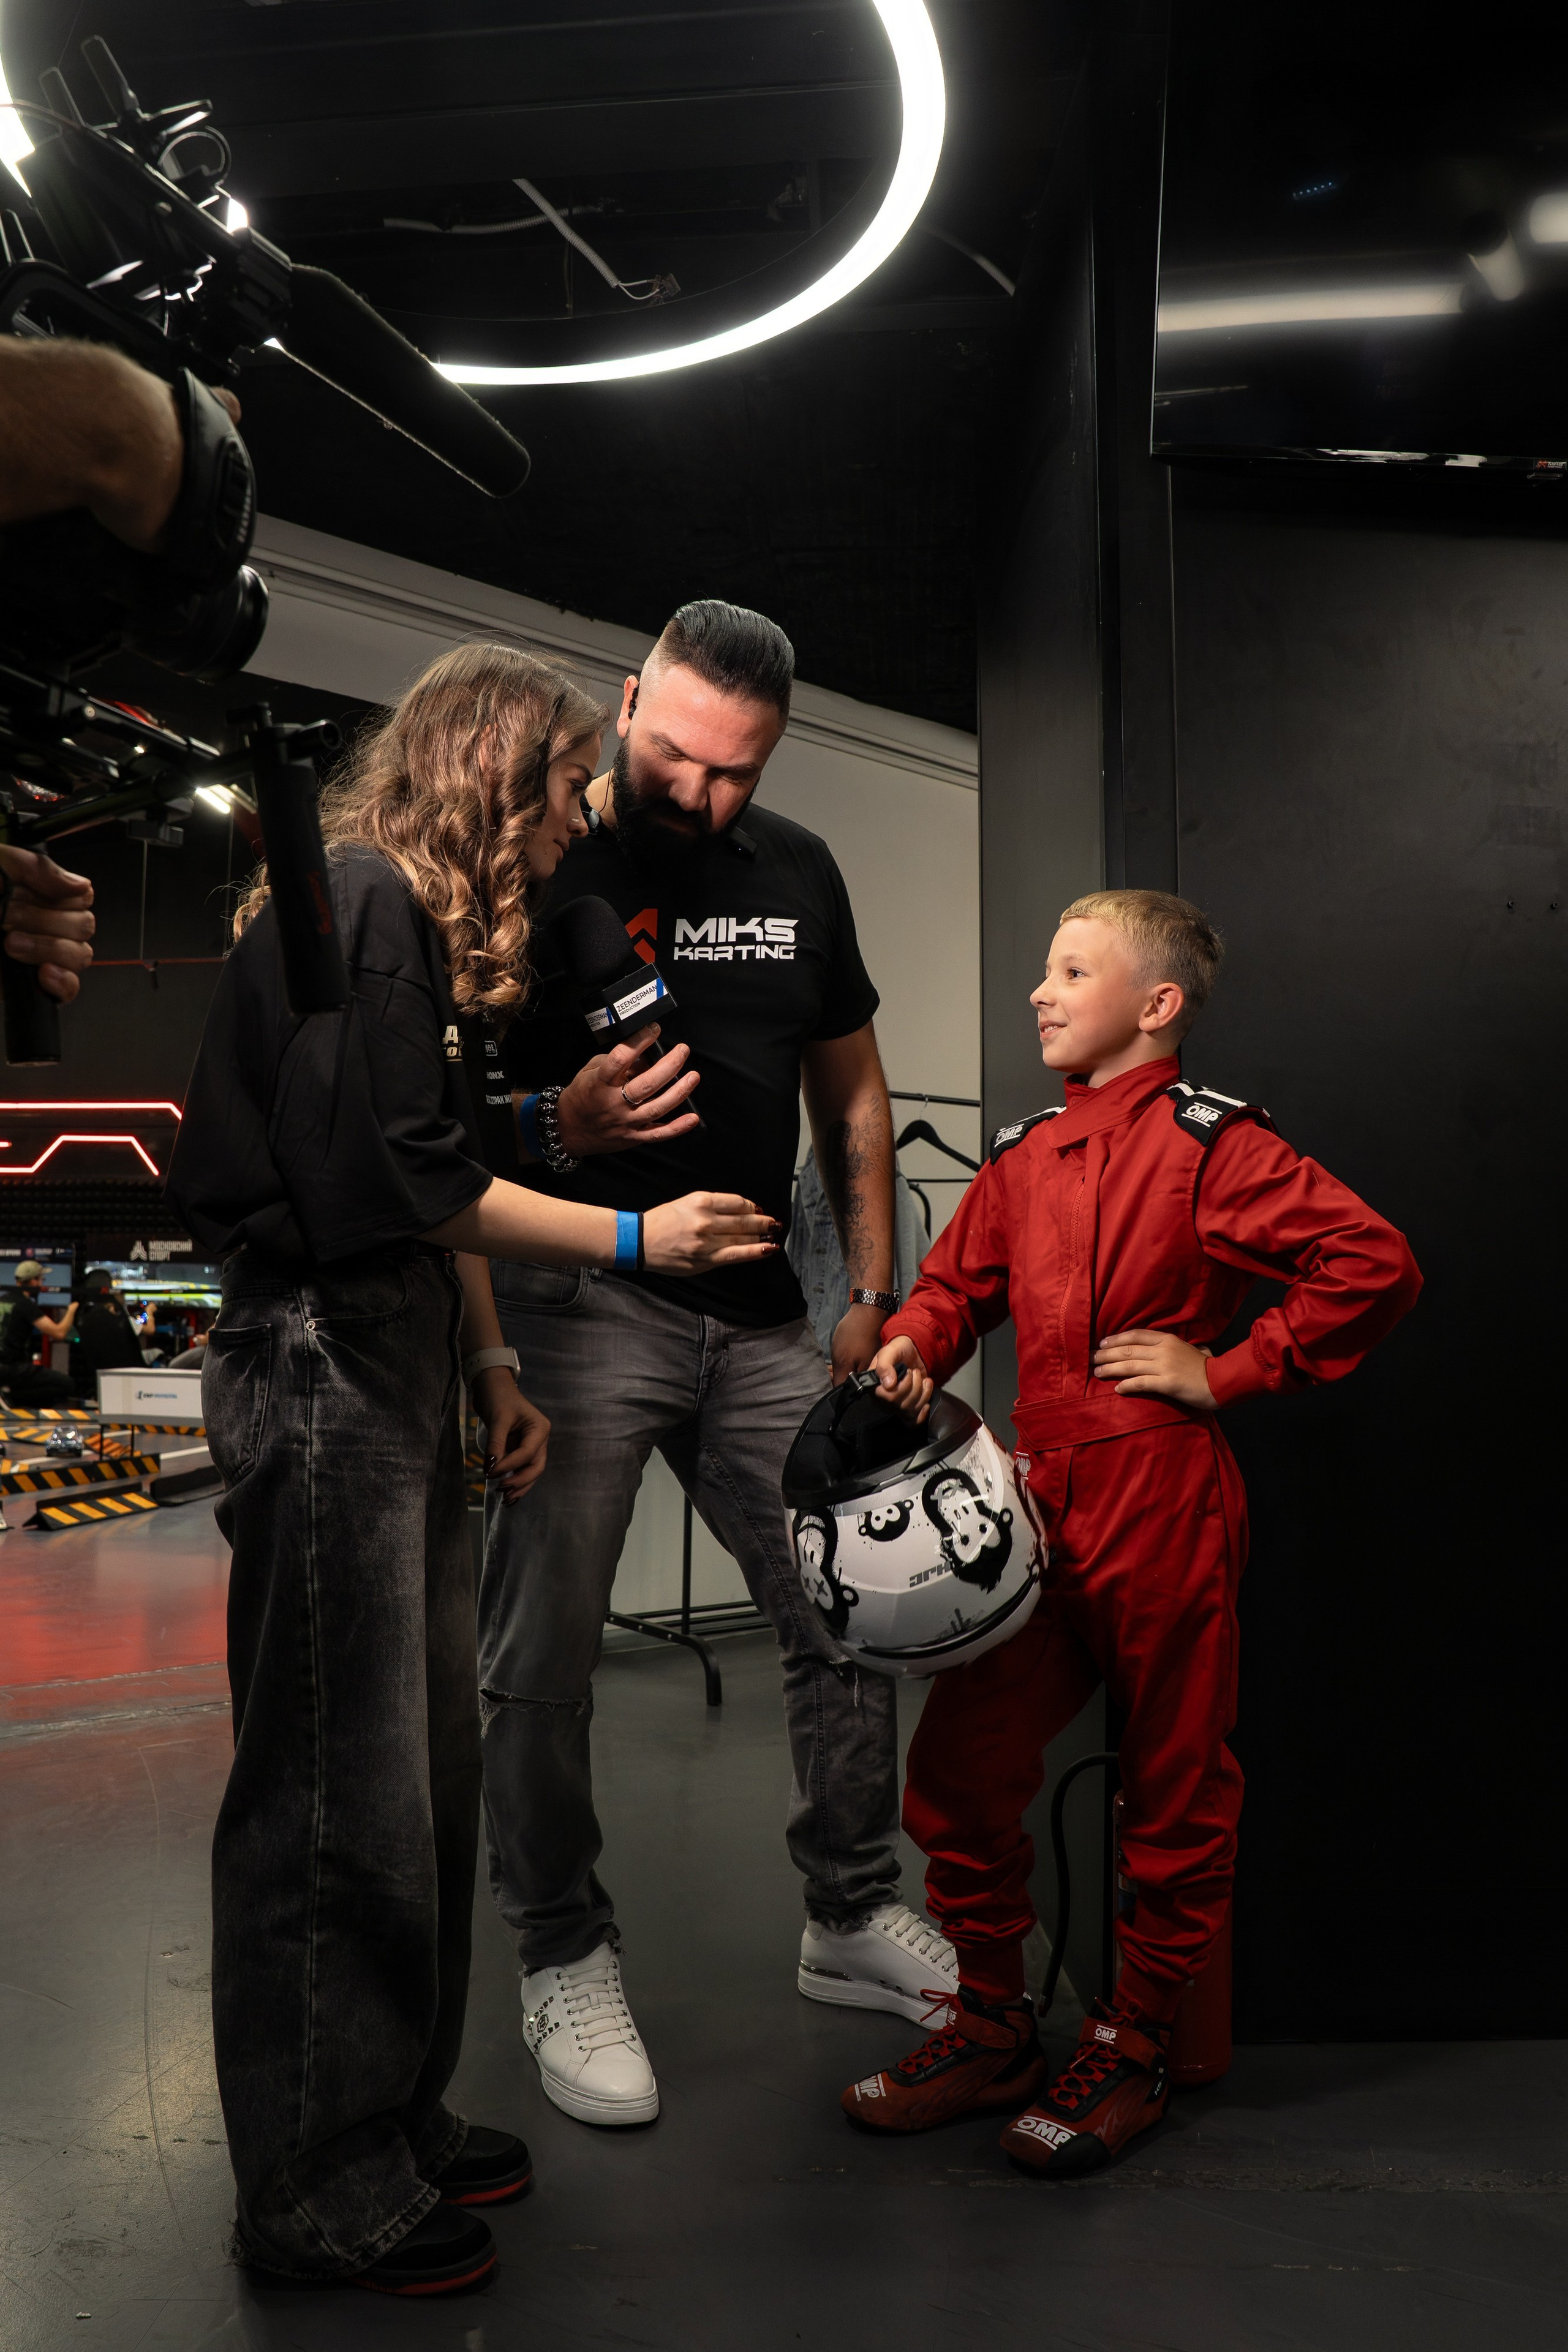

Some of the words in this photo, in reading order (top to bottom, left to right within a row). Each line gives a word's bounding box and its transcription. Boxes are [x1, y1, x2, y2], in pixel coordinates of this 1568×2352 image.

[675, 918, 799, 943] MIKS
[674, 944, 797, 960] KARTING
[616, 984, 657, 1012] ZEENDERMAN
[619, 1002, 641, 1016] PRODUCTION
[1186, 1105, 1219, 1123] OMP
[995, 1126, 1023, 1144] OMP
[1095, 2027, 1117, 2040] OMP
[1017, 2119, 1071, 2146] OMP
